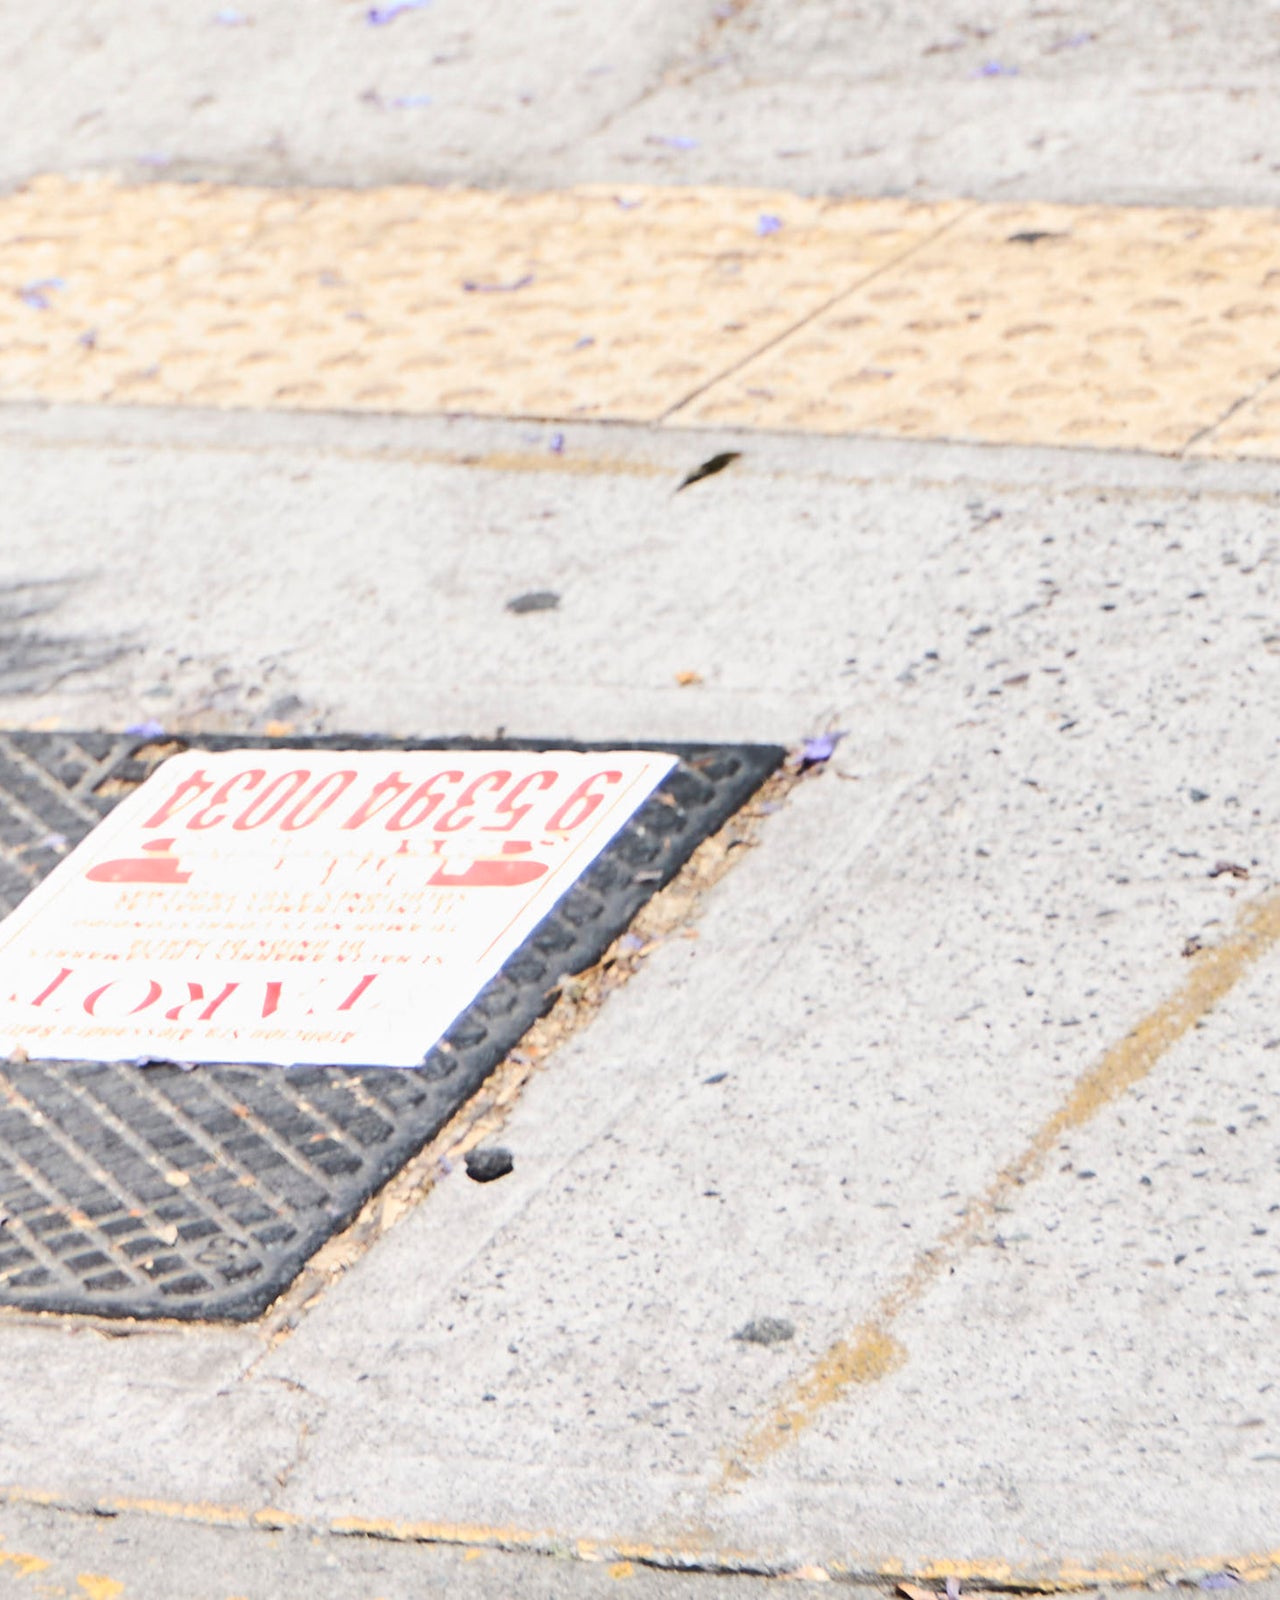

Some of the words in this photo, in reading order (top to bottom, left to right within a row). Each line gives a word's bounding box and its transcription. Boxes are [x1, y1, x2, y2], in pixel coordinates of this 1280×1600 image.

[142, 768, 359, 832] 0034
[342, 768, 559, 832] 5394
[544, 768, 624, 832] 9
[7, 967, 382, 1022] TAROT
